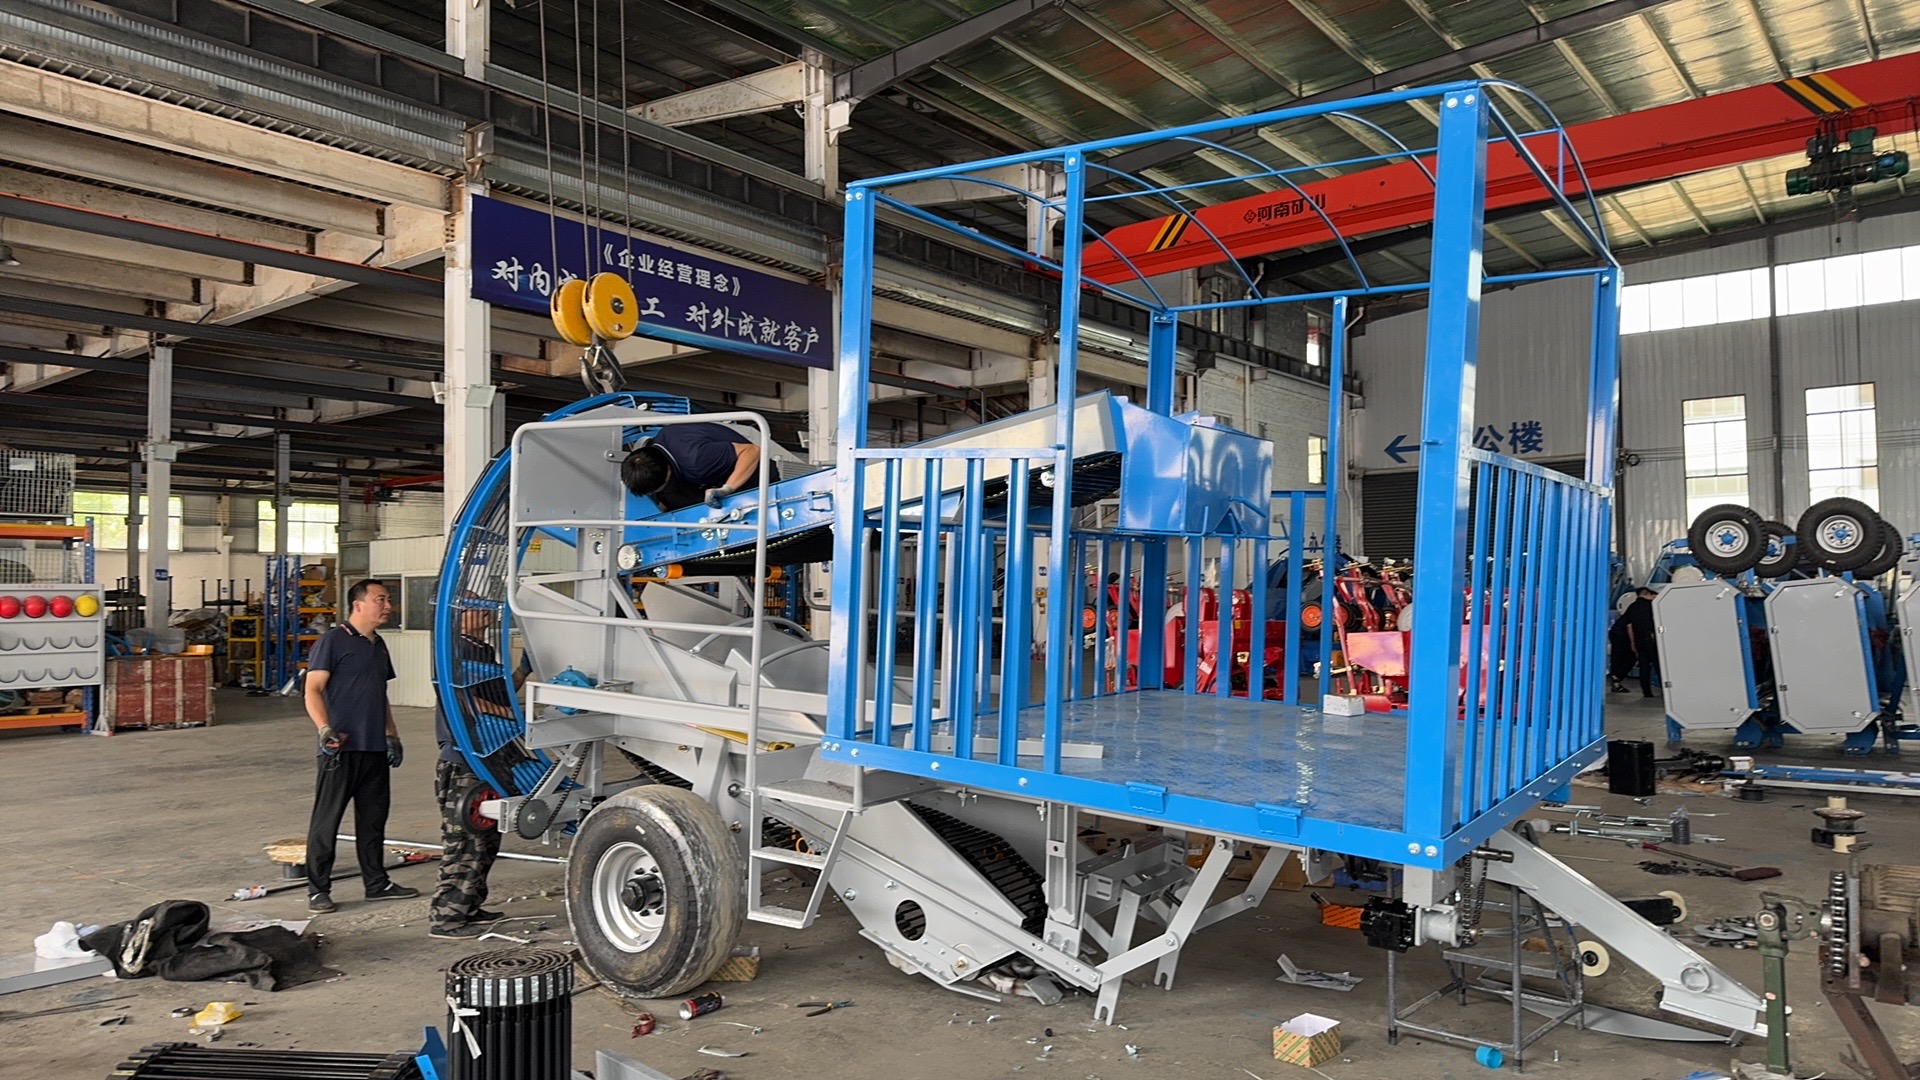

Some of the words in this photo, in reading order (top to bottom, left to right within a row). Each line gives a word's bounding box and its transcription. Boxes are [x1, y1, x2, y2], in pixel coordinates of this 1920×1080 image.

[1257, 194, 1326, 222] 河南矿山
[603, 243, 741, 297] 《企业经营理念》
[685, 301, 820, 354] 对外成就客户
[1472, 420, 1544, 454] 公楼
